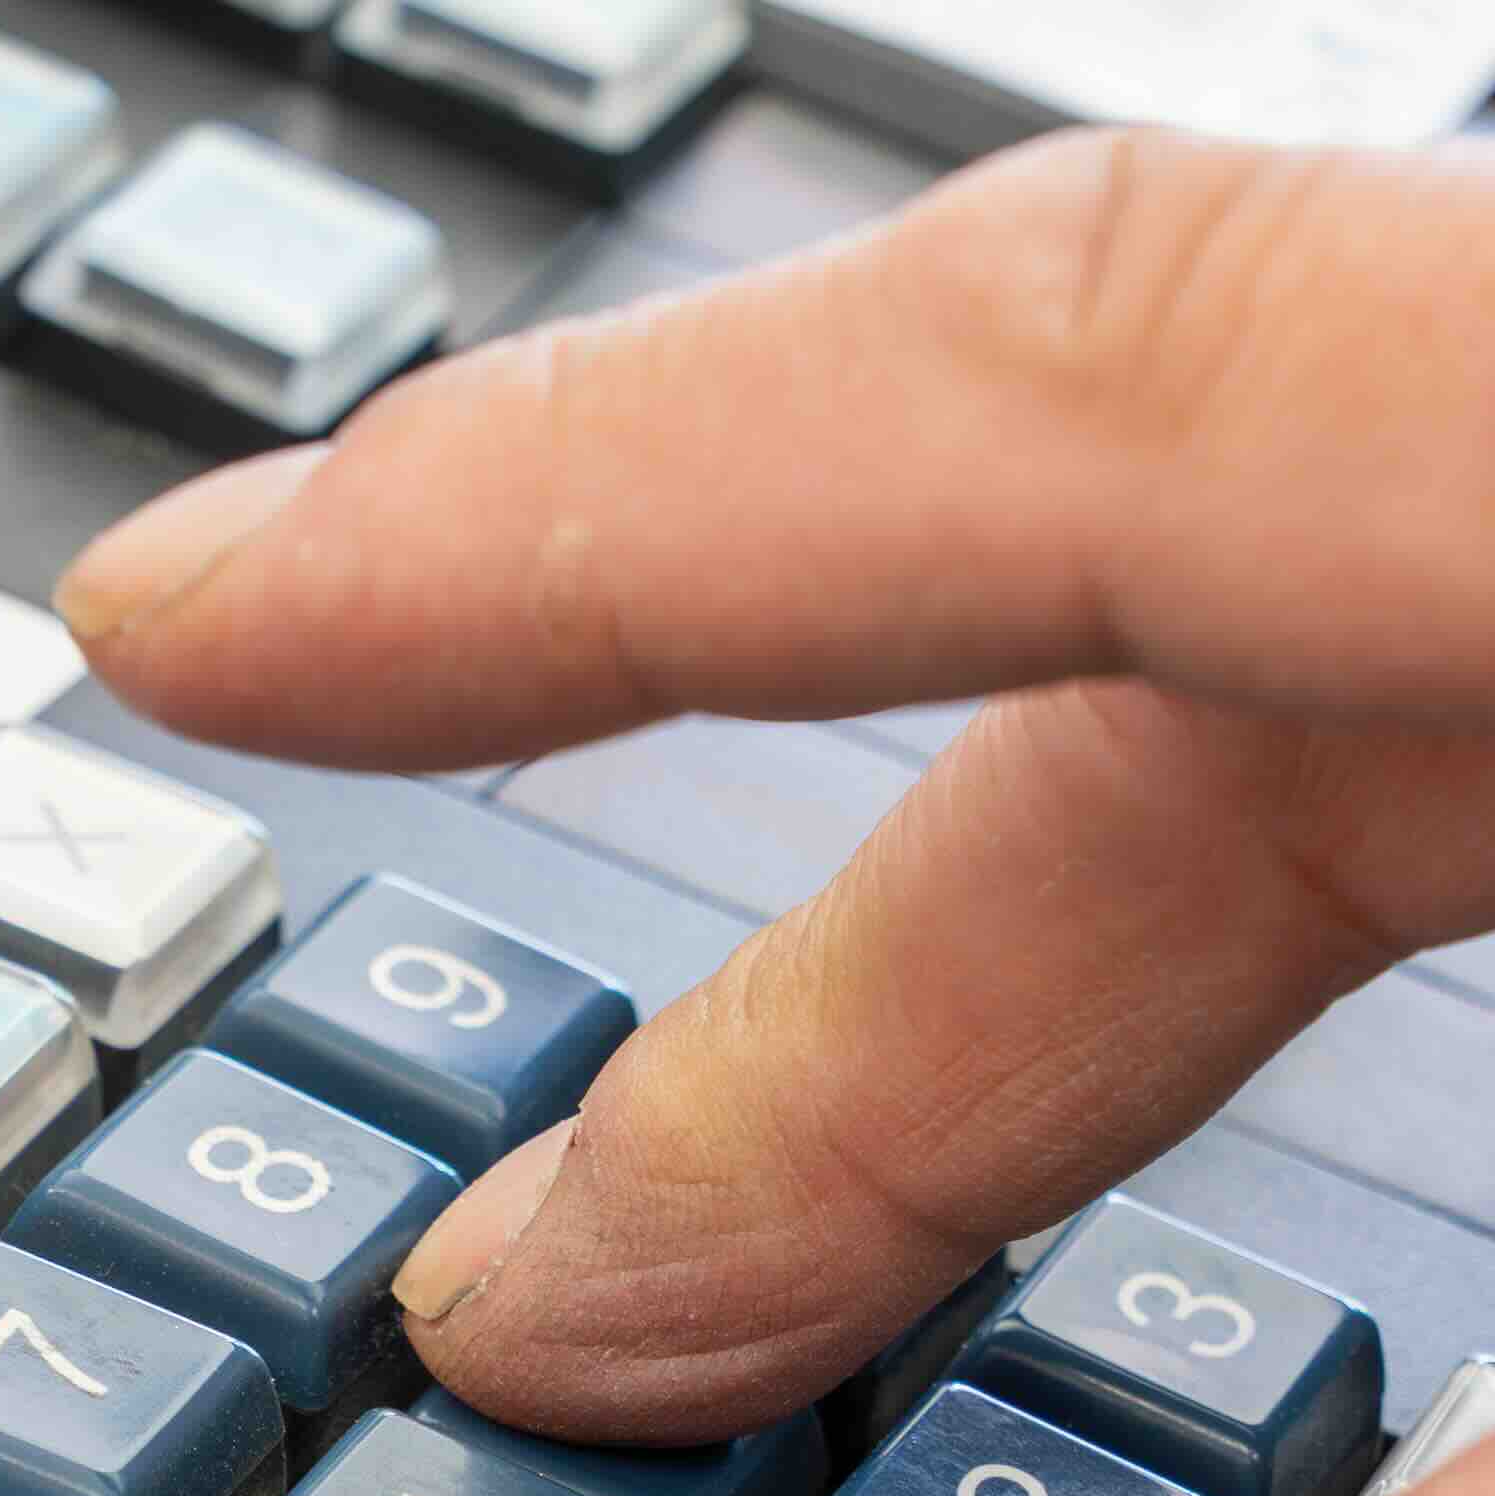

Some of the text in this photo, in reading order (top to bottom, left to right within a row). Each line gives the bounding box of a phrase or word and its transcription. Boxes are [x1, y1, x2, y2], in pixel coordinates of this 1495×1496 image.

[367, 943, 508, 1029] 9
[186, 1125, 332, 1214] 8
[1114, 1270, 1258, 1360] 3
